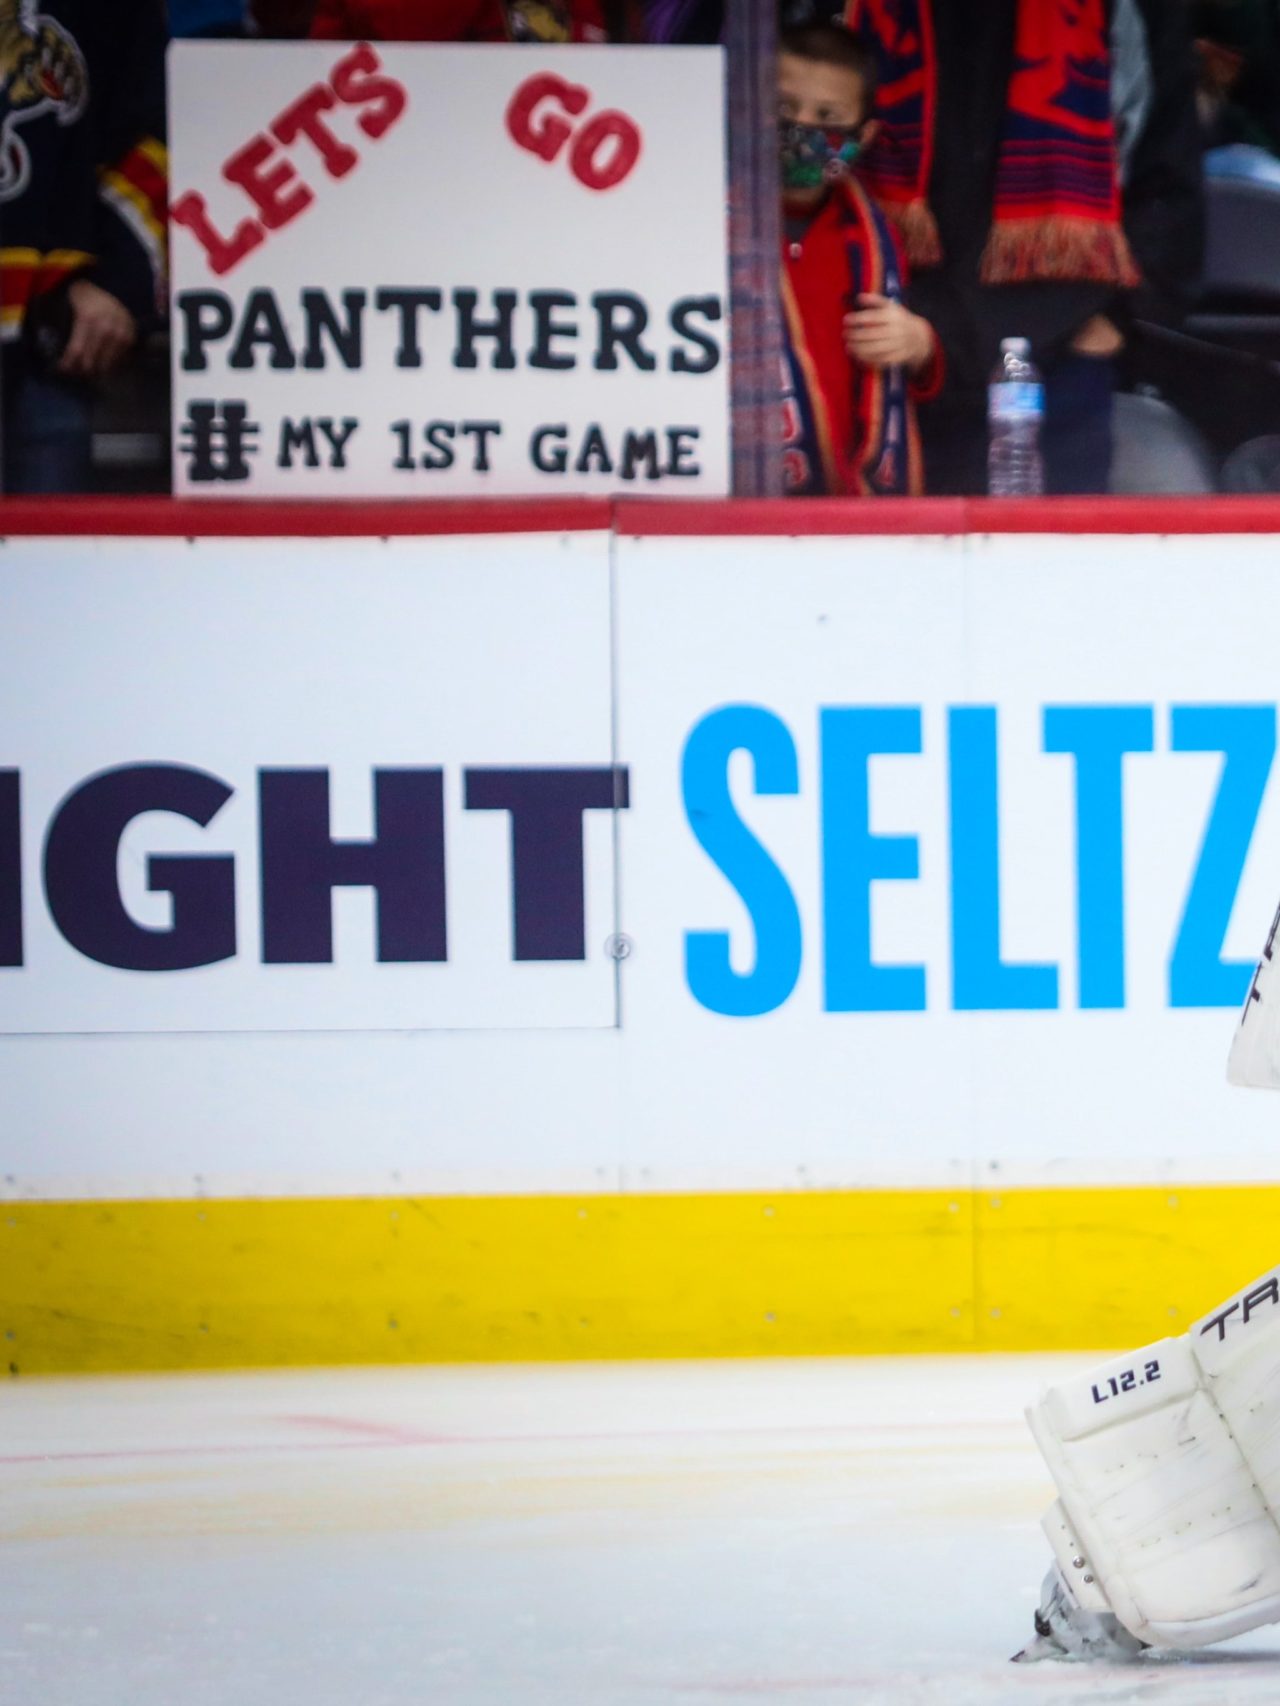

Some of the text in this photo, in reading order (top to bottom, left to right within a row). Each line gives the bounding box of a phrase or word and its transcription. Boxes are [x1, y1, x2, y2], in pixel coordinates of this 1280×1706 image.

[170, 42, 643, 275] LETS GO
[177, 287, 723, 374] PANTHERS
[277, 417, 359, 469] MY
[391, 421, 502, 473] 1ST
[529, 423, 701, 480] GAME
[0, 761, 629, 972] GHT
[1090, 1359, 1162, 1404] L12.2
